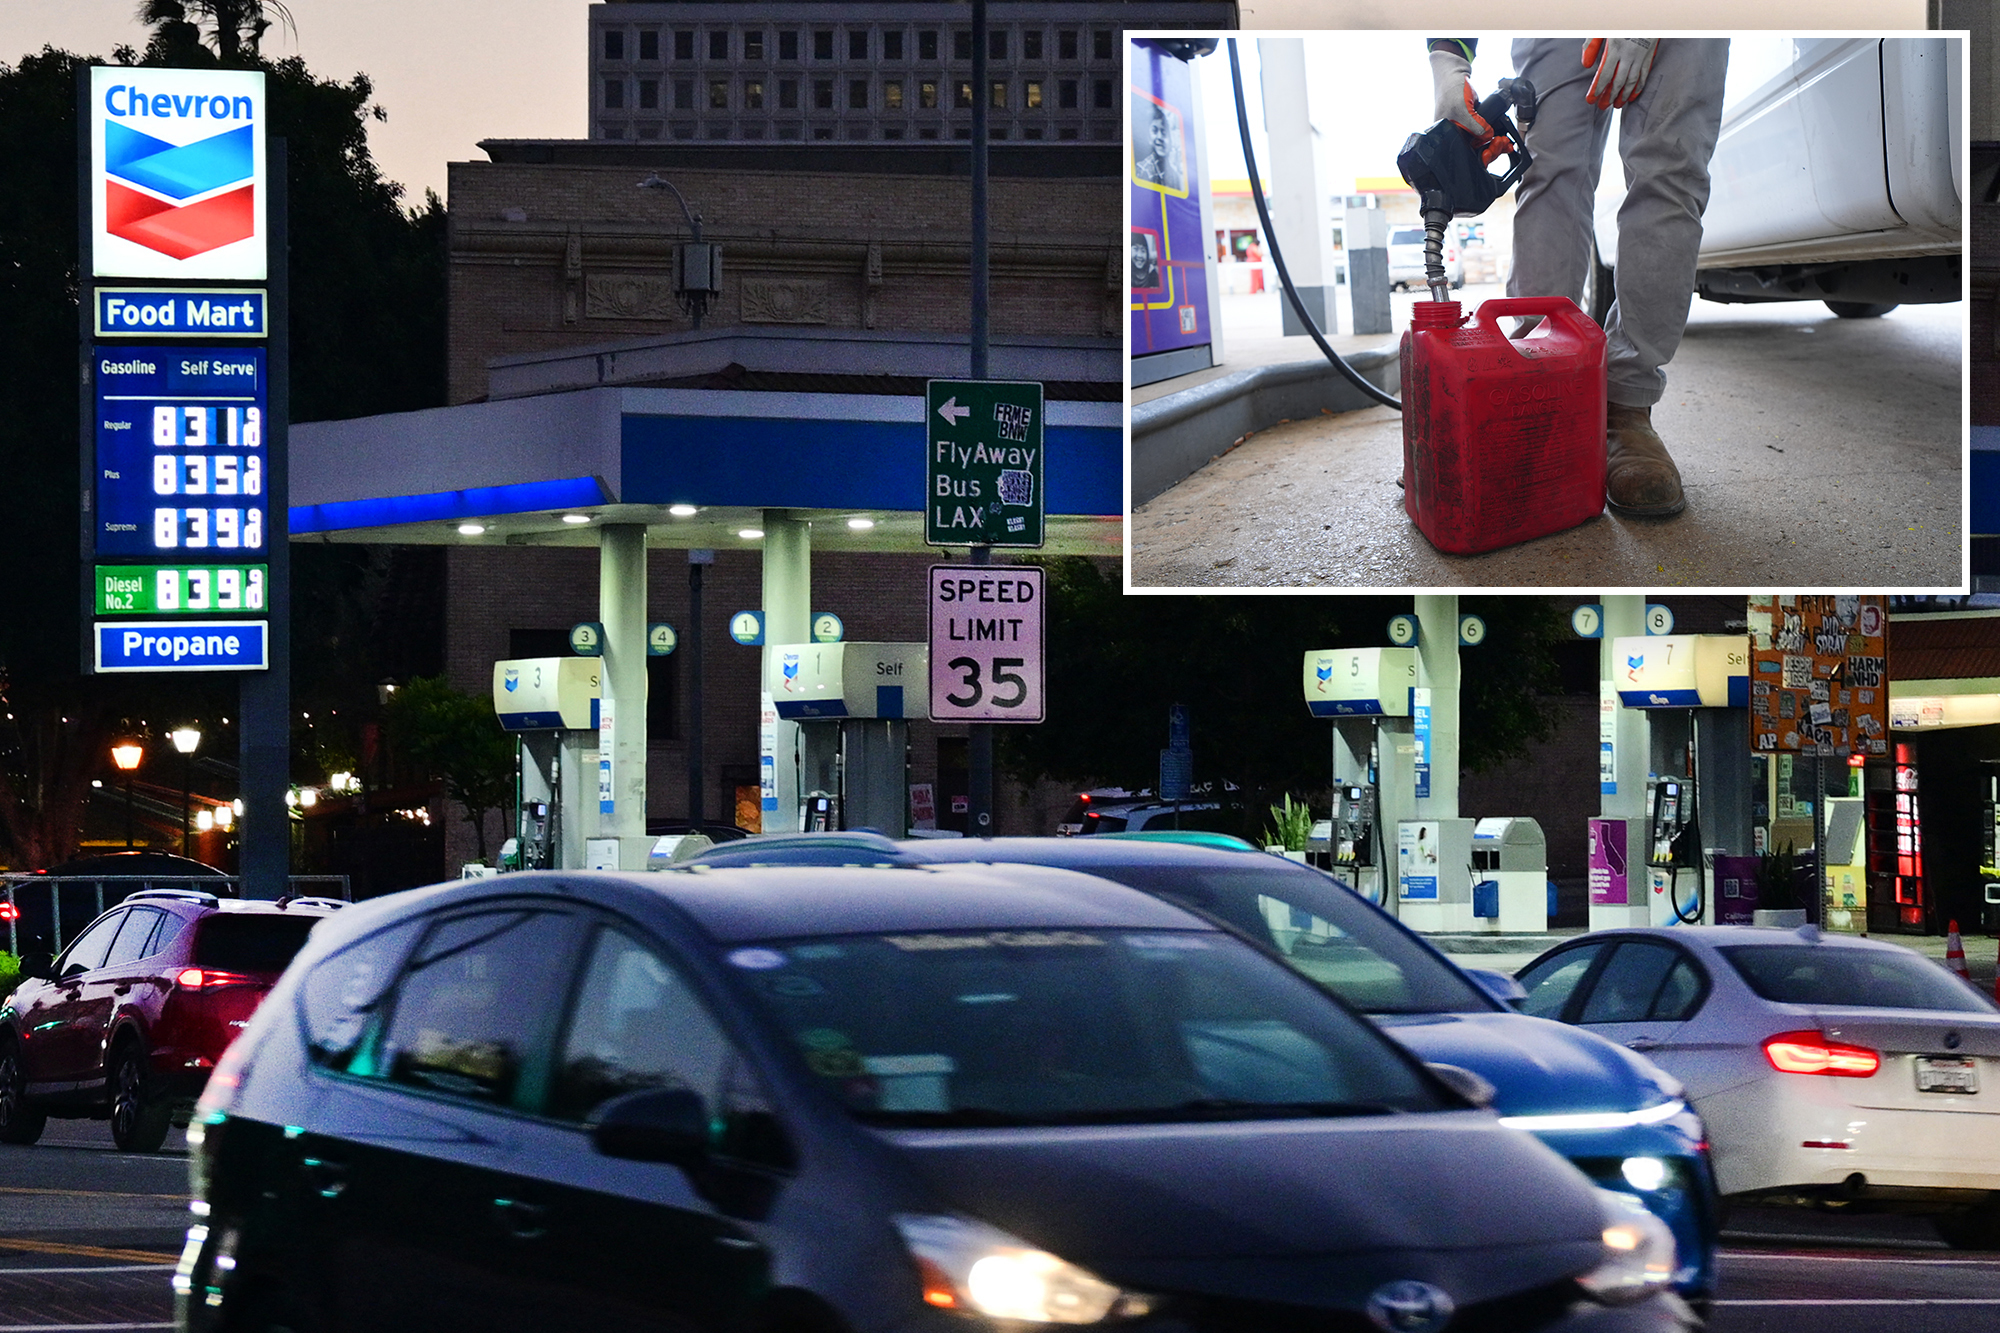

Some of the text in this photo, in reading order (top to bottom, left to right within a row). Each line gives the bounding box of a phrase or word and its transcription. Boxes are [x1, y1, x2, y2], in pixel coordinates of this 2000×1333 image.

[105, 84, 253, 120] Chevron
[107, 298, 254, 327] Food Mart
[101, 359, 156, 375] Gasoline
[181, 360, 254, 376] Self Serve
[1489, 378, 1584, 407] GASOLINE
[104, 420, 132, 432] Regular
[937, 440, 1036, 471] FlyAway
[104, 469, 121, 480] Plus
[937, 474, 981, 497] Bus
[936, 505, 984, 528] LAX
[105, 522, 137, 533] Supreme
[105, 576, 143, 592] Diesel
[940, 579, 1034, 603] SPEED
[105, 593, 134, 610] No.2
[743, 619, 748, 632] 1
[823, 621, 831, 634] 2
[1582, 614, 1591, 628] 7
[1654, 613, 1664, 627] 8
[581, 630, 589, 642] 3
[658, 631, 667, 643] 4
[950, 618, 1023, 641] LIMIT
[1397, 623, 1405, 637] 5
[1468, 623, 1477, 637] 6
[123, 631, 240, 661] Propane
[1666, 644, 1673, 665] 7
[816, 652, 820, 675] 1
[876, 661, 903, 676] Self
[1351, 656, 1359, 677] 5
[1848, 656, 1885, 673] HARM
[534, 666, 541, 688] 3
[946, 656, 1027, 708] 35
[1758, 732, 1777, 750] AP
